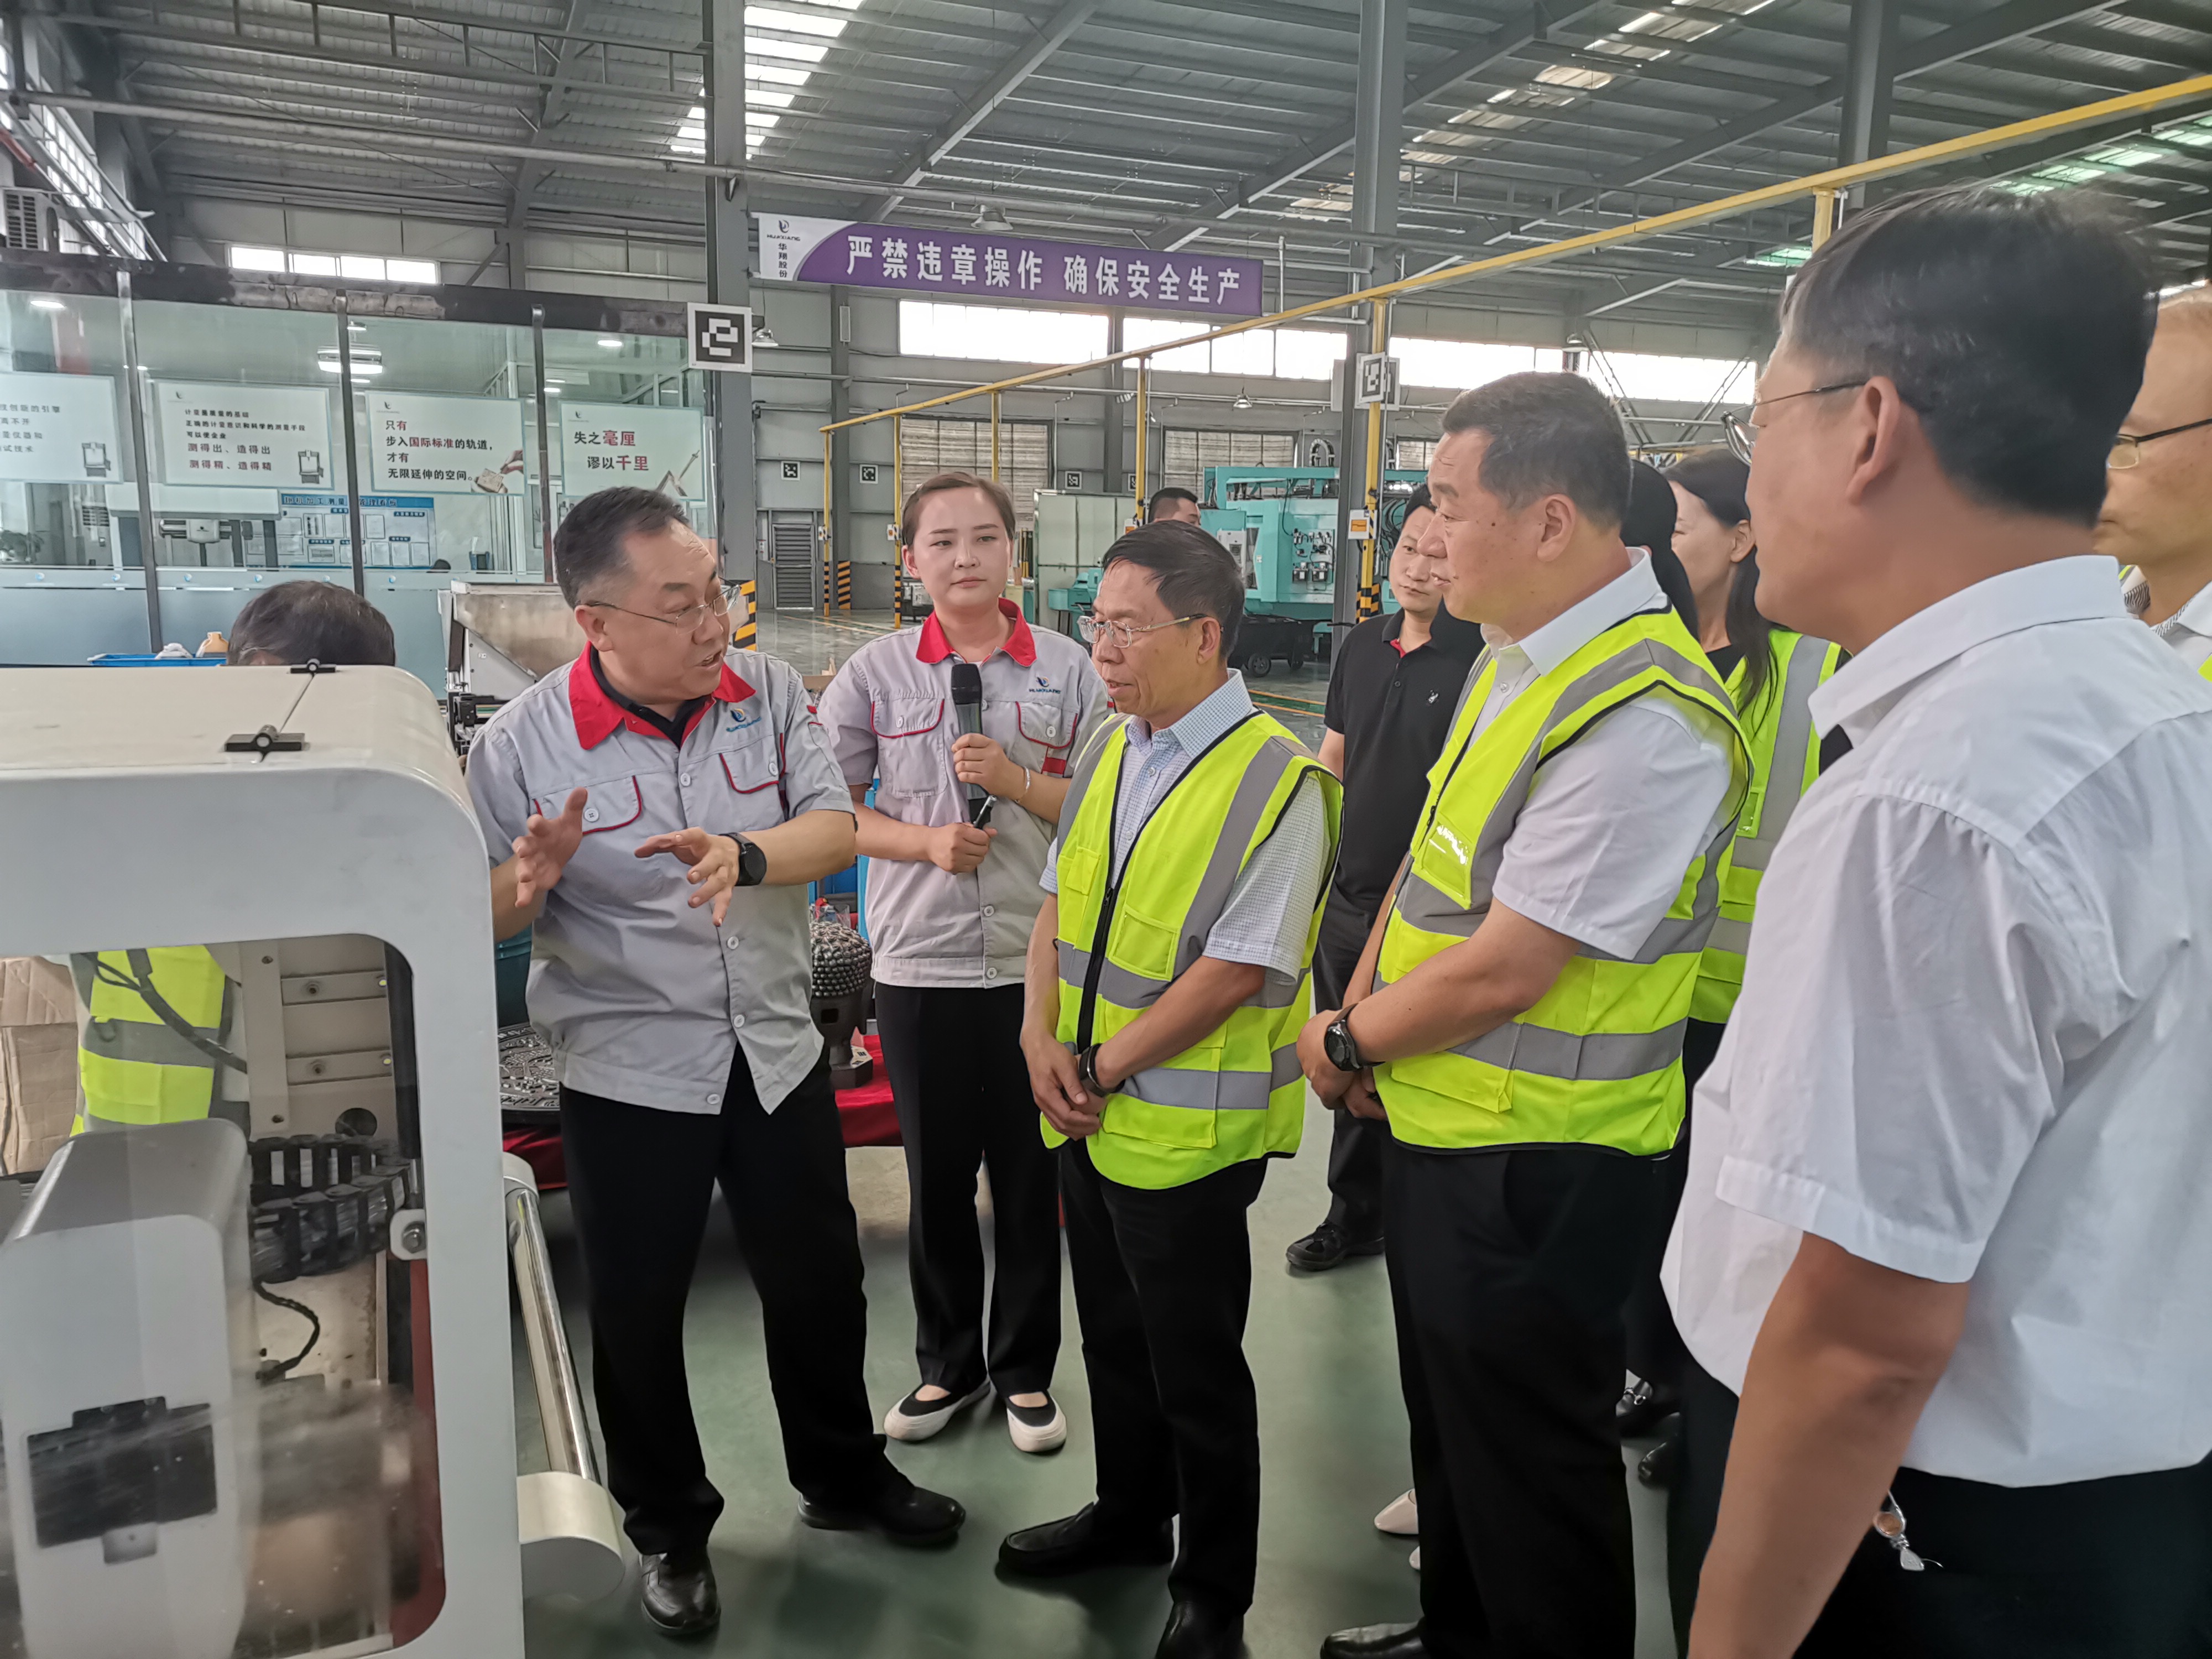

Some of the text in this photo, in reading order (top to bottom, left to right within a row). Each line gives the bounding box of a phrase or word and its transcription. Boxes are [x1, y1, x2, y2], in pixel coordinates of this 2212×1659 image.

[778, 243, 787, 278] 华翔股份
[847, 236, 1240, 305] 严禁违章操作 确保安全生产
[385, 420, 407, 430] 只有
[386, 436, 493, 450] 步入国际标准的轨道，
[574, 430, 636, 446] 失之毫厘
[387, 452, 409, 462] 才有
[587, 455, 649, 471] 谬以千里
[388, 468, 473, 481] 无限延伸的空间。
